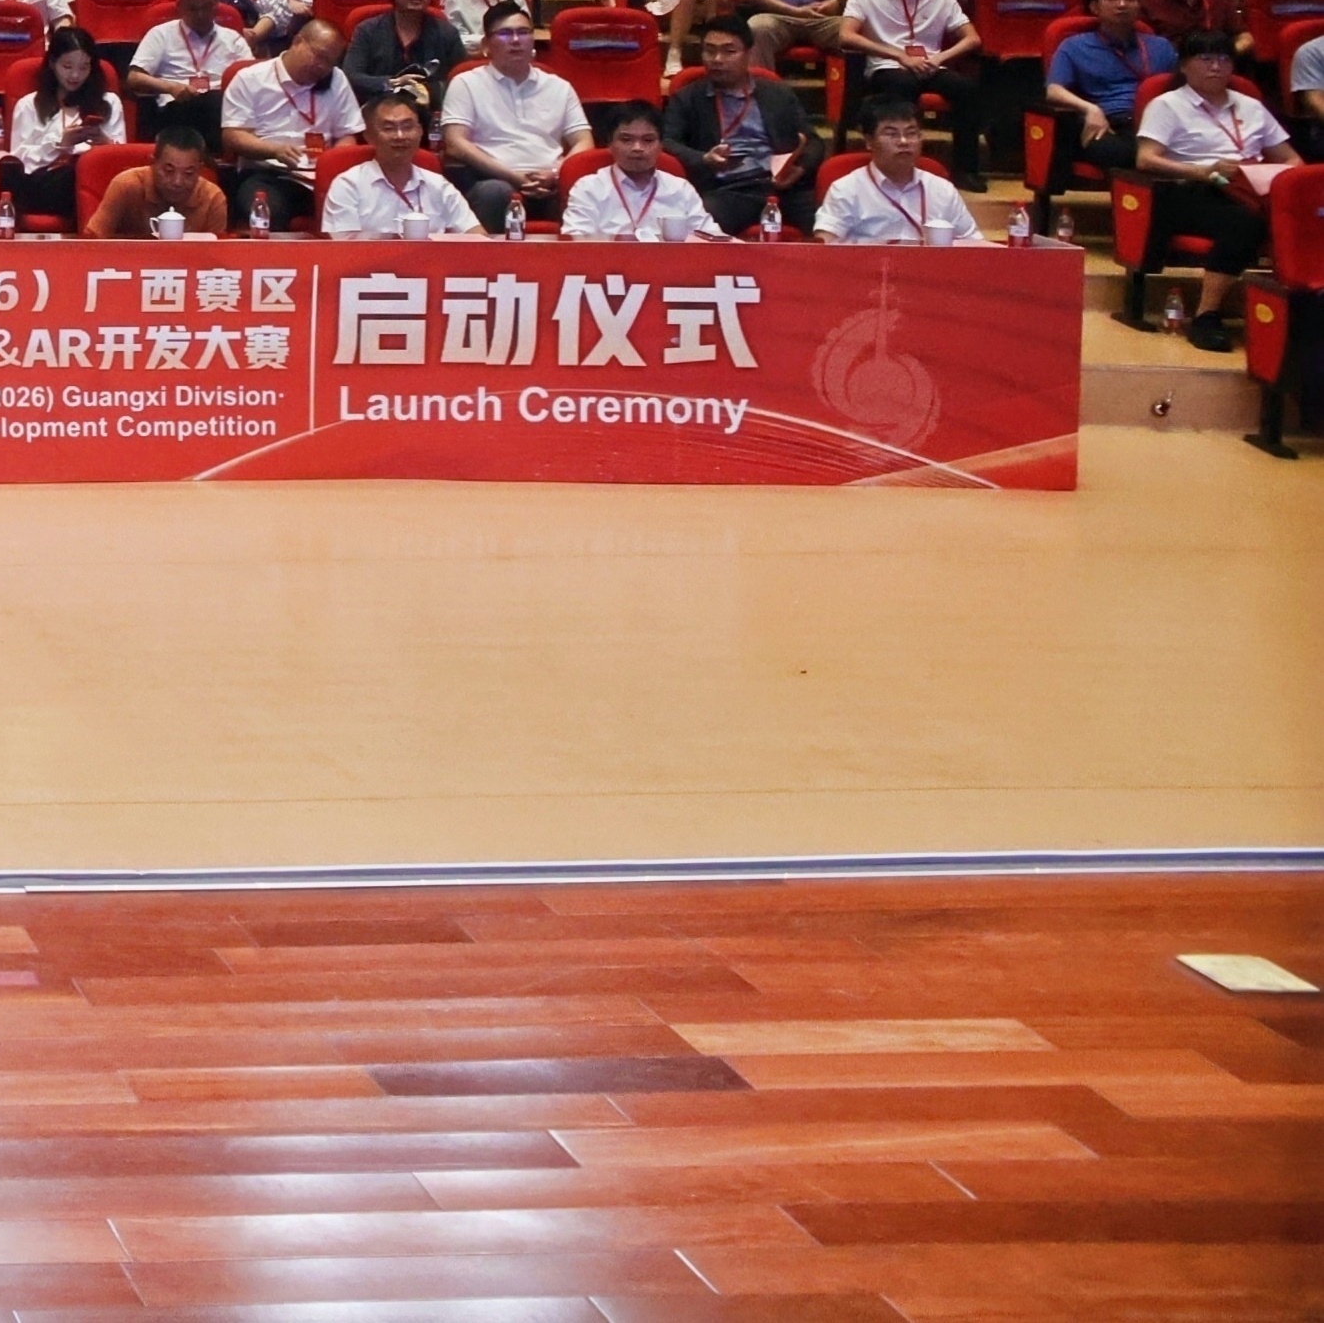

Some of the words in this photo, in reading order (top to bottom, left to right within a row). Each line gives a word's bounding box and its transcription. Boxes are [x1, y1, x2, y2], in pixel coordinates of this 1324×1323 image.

[333, 273, 761, 368] 启动仪式
[62, 385, 166, 412] Guangxi
[339, 385, 502, 422] Launch
[518, 386, 748, 435] Ceremony
[117, 415, 276, 442] Competition
